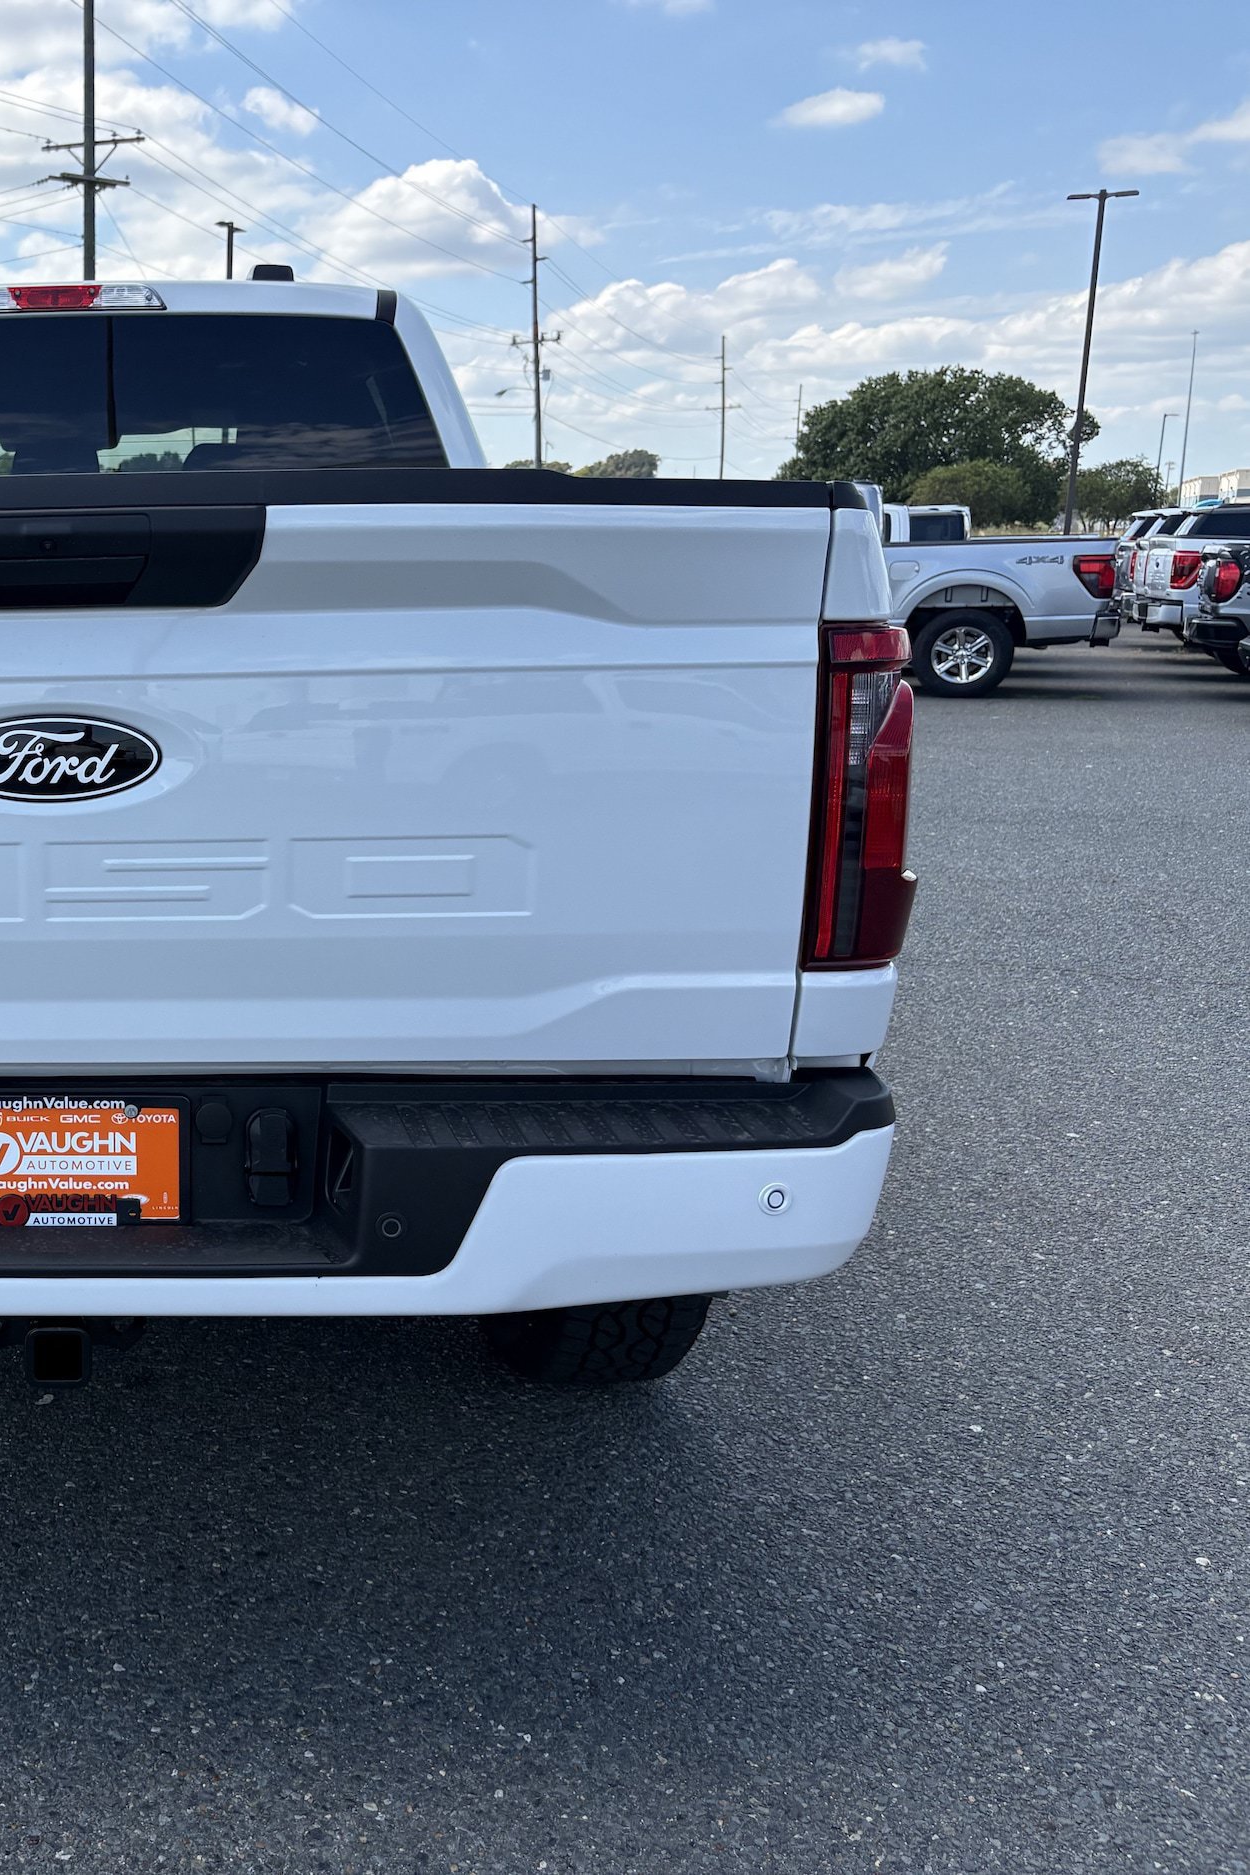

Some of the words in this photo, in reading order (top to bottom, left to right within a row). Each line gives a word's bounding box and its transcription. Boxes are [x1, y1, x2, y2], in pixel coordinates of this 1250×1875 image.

[59, 1114, 101, 1124] GMC
[16, 1131, 137, 1154] VAUGHN
[26, 1160, 132, 1171] AUTOMOTIVE
[23, 1194, 118, 1213] VAUGHN
[32, 1216, 114, 1226] AUTOMOTIVE
